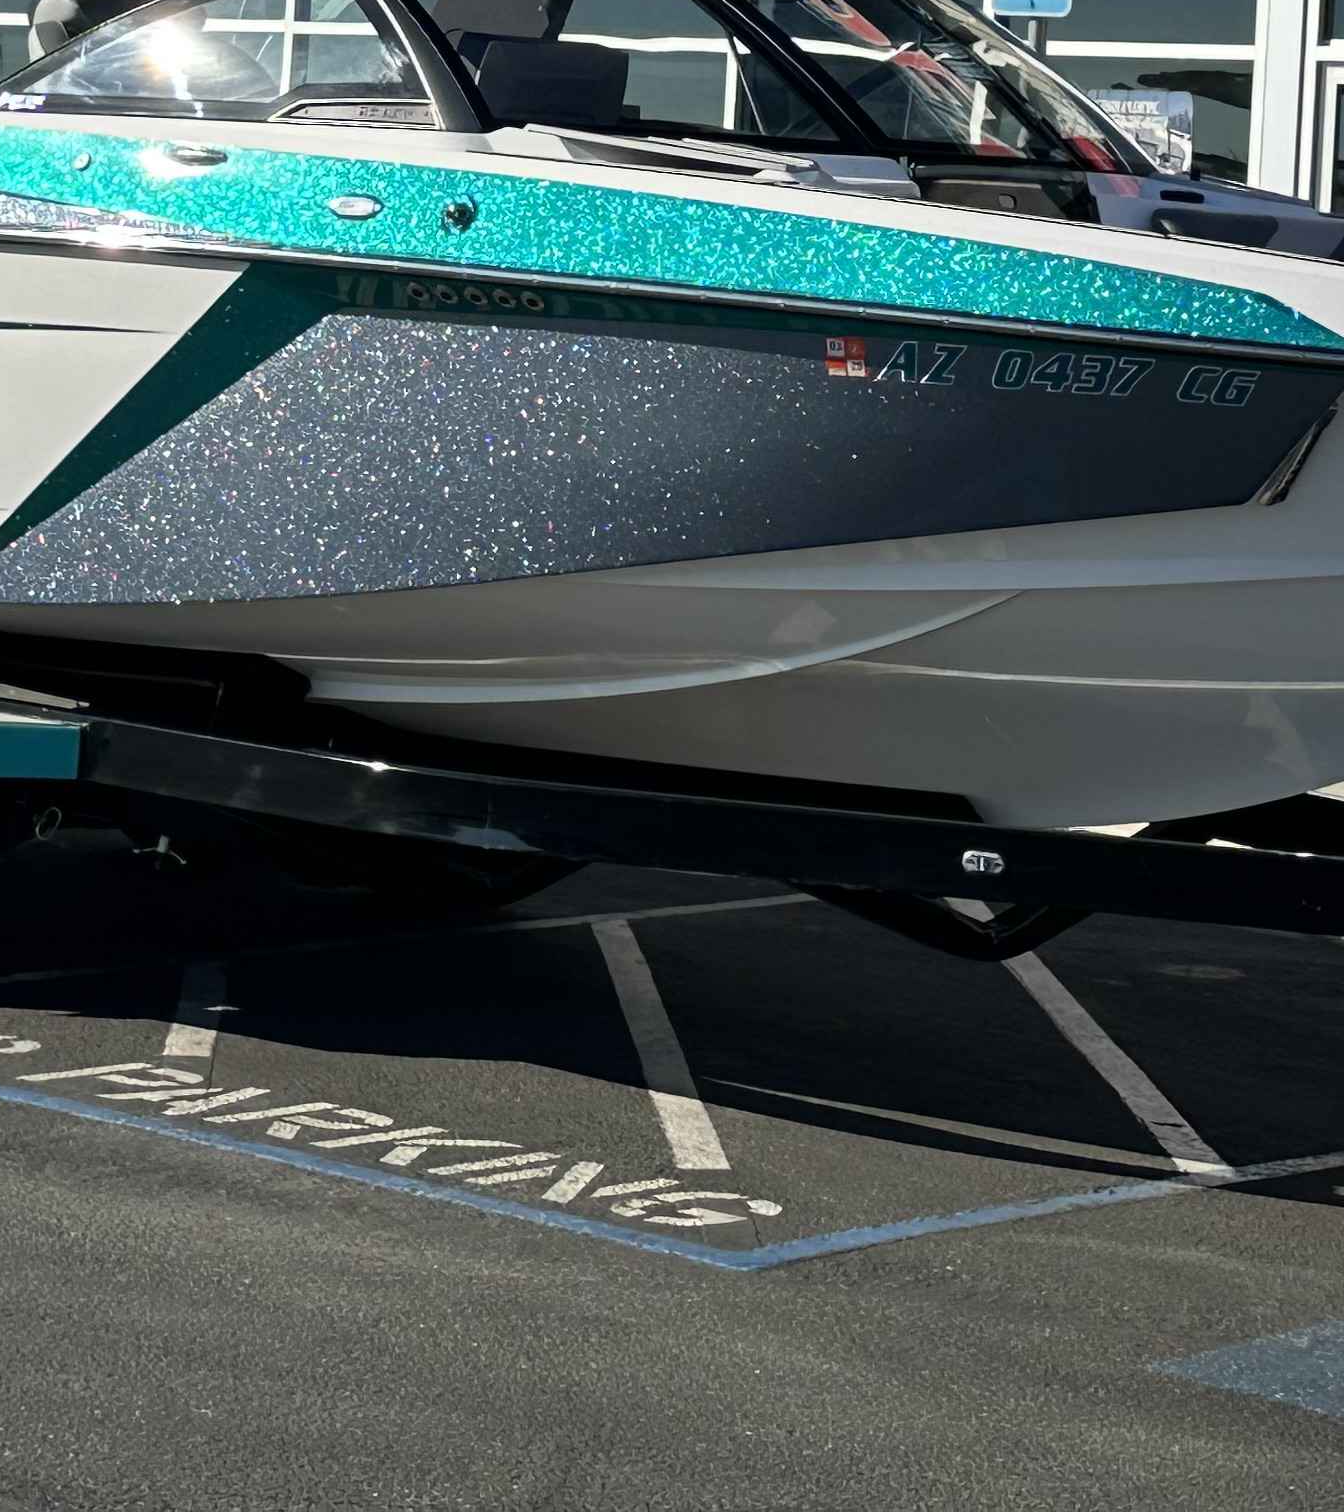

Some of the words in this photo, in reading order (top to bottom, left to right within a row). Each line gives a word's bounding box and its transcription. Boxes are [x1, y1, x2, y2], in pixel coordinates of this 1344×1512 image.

[871, 340, 968, 386] AZ
[990, 348, 1156, 397] 0437
[1175, 365, 1262, 407] CG
[15, 1060, 785, 1229] PARKING
